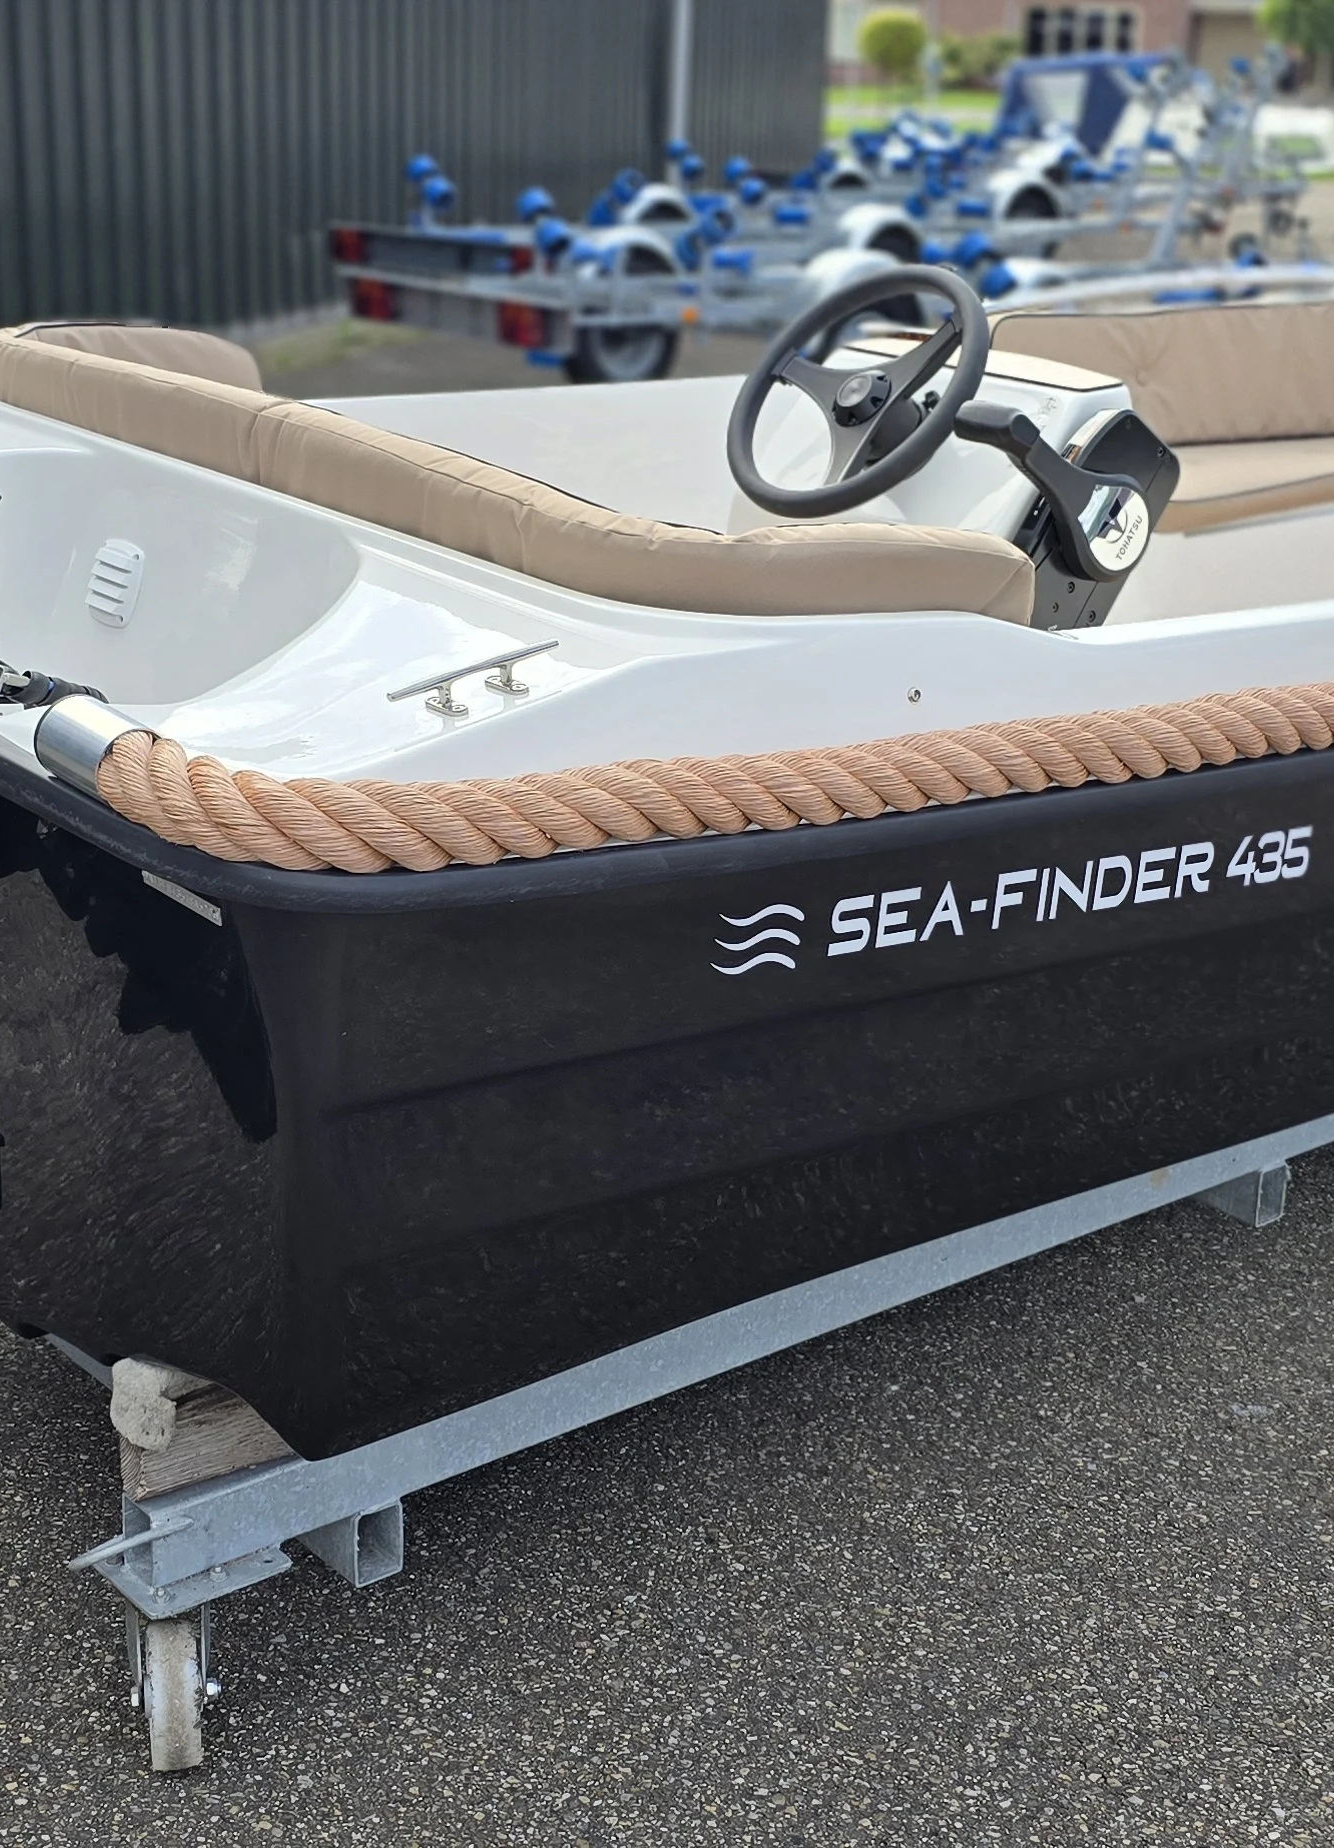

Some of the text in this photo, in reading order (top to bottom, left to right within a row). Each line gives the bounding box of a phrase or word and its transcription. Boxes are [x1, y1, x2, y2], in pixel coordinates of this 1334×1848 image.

[1115, 515, 1143, 561] TOHATSU
[827, 825, 1313, 956] SEA-FINDER 435
